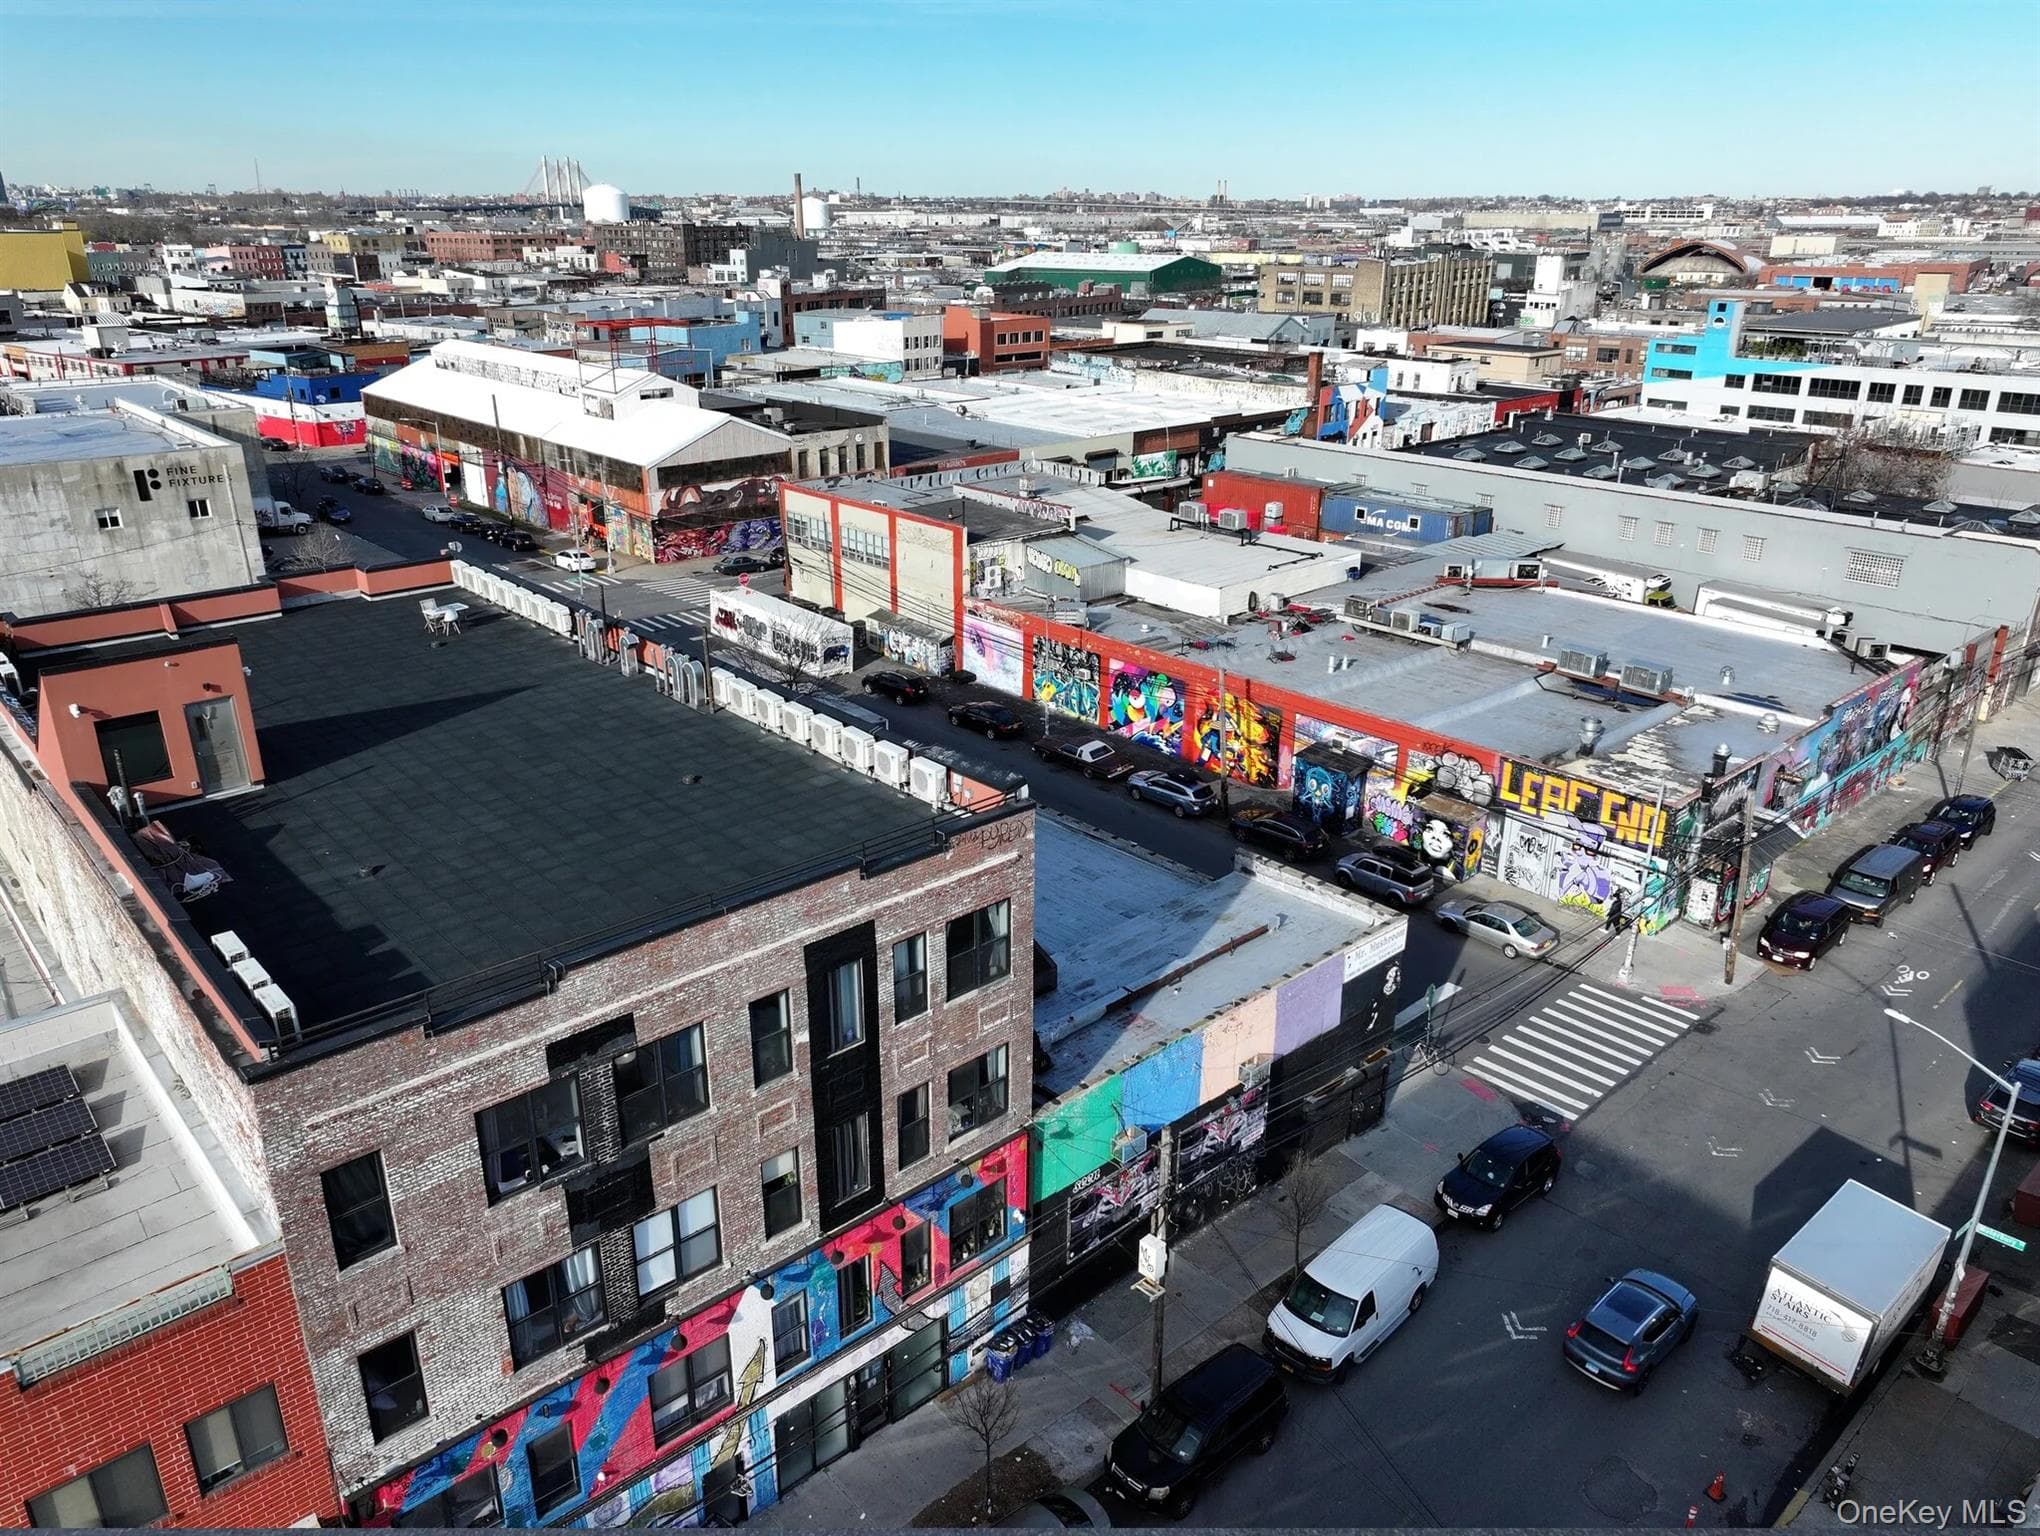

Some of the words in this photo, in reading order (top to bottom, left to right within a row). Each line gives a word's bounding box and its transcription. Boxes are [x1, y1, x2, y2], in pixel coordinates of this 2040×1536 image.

[166, 465, 197, 476] FINE
[1360, 515, 1384, 528] MA
[1500, 761, 1598, 817] LEAF
[1770, 1292, 1810, 1319] STAIRS
[1774, 1288, 1832, 1325] ATLANTIC
